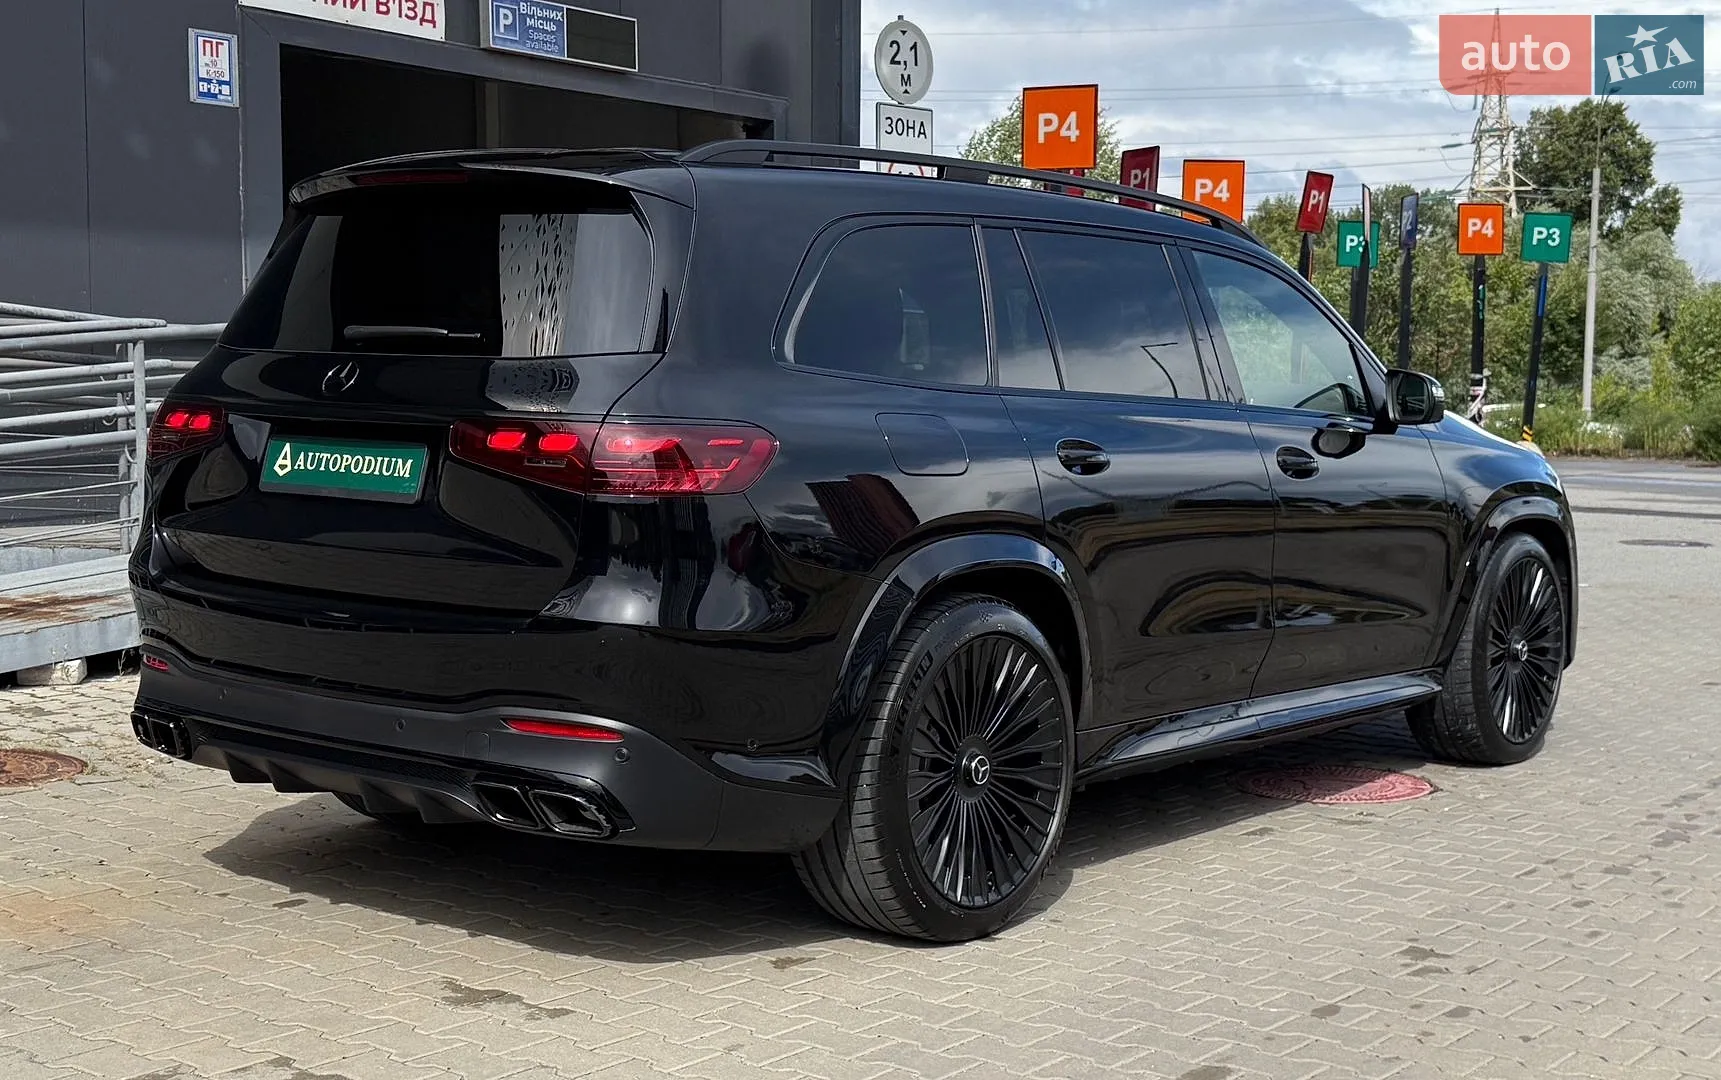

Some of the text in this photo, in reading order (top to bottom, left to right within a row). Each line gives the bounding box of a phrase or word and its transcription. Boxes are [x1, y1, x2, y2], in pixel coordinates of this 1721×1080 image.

[500, 8, 513, 33] P
[520, 2, 563, 21] Вільних
[526, 16, 557, 32] місць
[525, 41, 559, 53] available
[528, 30, 557, 42] Spaces
[202, 40, 224, 58] ПГ
[889, 40, 918, 71] 2,1
[885, 117, 927, 139] ЗОНА
[1038, 110, 1080, 144] P4
[1130, 168, 1151, 191] P1
[1194, 178, 1231, 203] P4
[1307, 190, 1325, 214] P1
[1467, 218, 1496, 238] P4
[1532, 227, 1561, 247] P3
[294, 451, 413, 478] AUTOPODIUM
